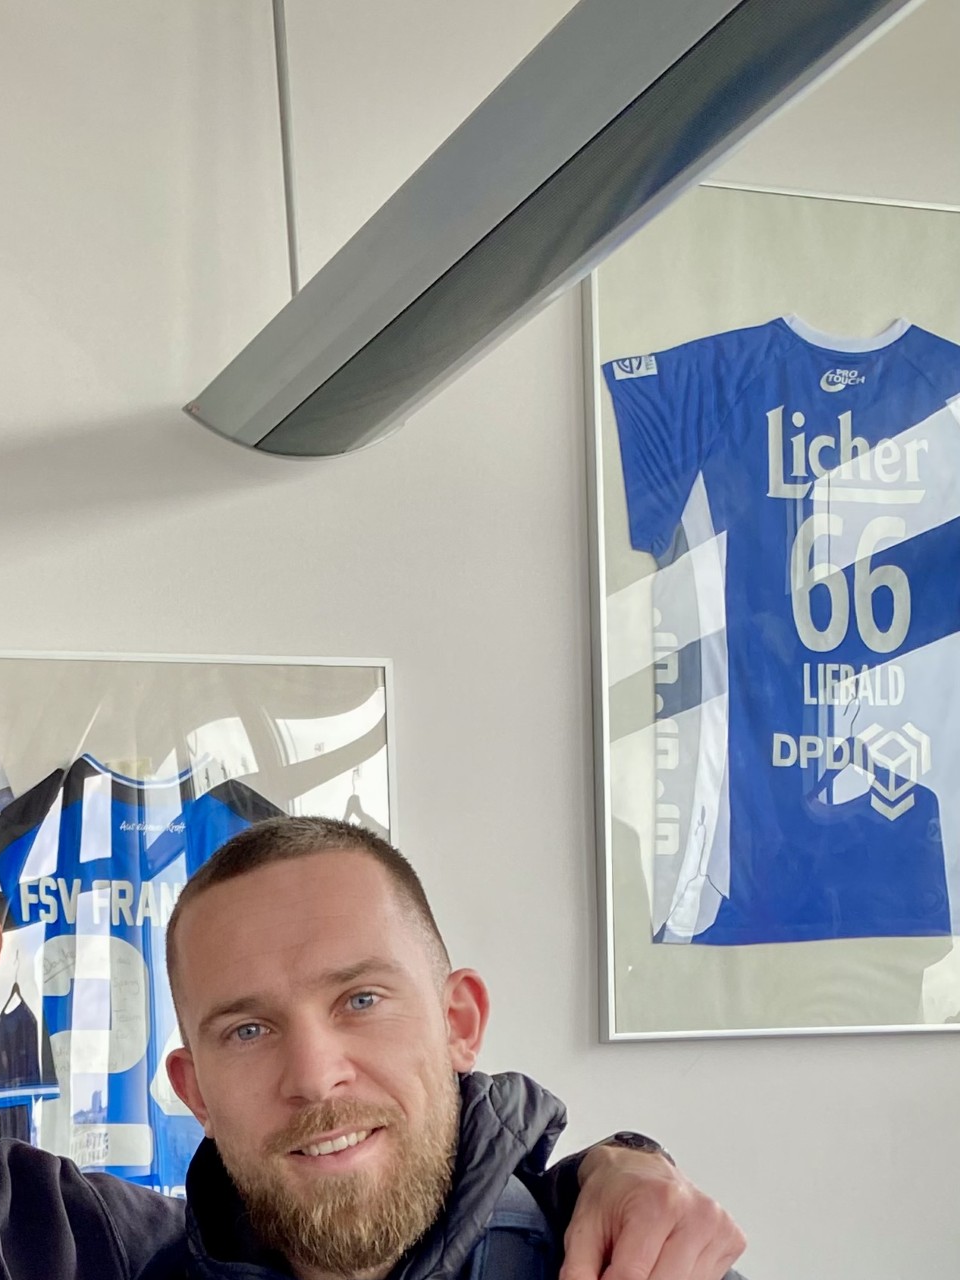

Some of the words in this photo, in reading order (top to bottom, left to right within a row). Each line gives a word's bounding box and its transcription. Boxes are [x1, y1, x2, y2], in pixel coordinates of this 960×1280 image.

[828, 374, 866, 385] TOUCH
[836, 369, 859, 378] PRO
[766, 405, 928, 499] Licher
[791, 513, 911, 654] 66
[803, 663, 906, 706] LIEBALD
[772, 733, 850, 770] DPD
[19, 877, 81, 924] FSV
